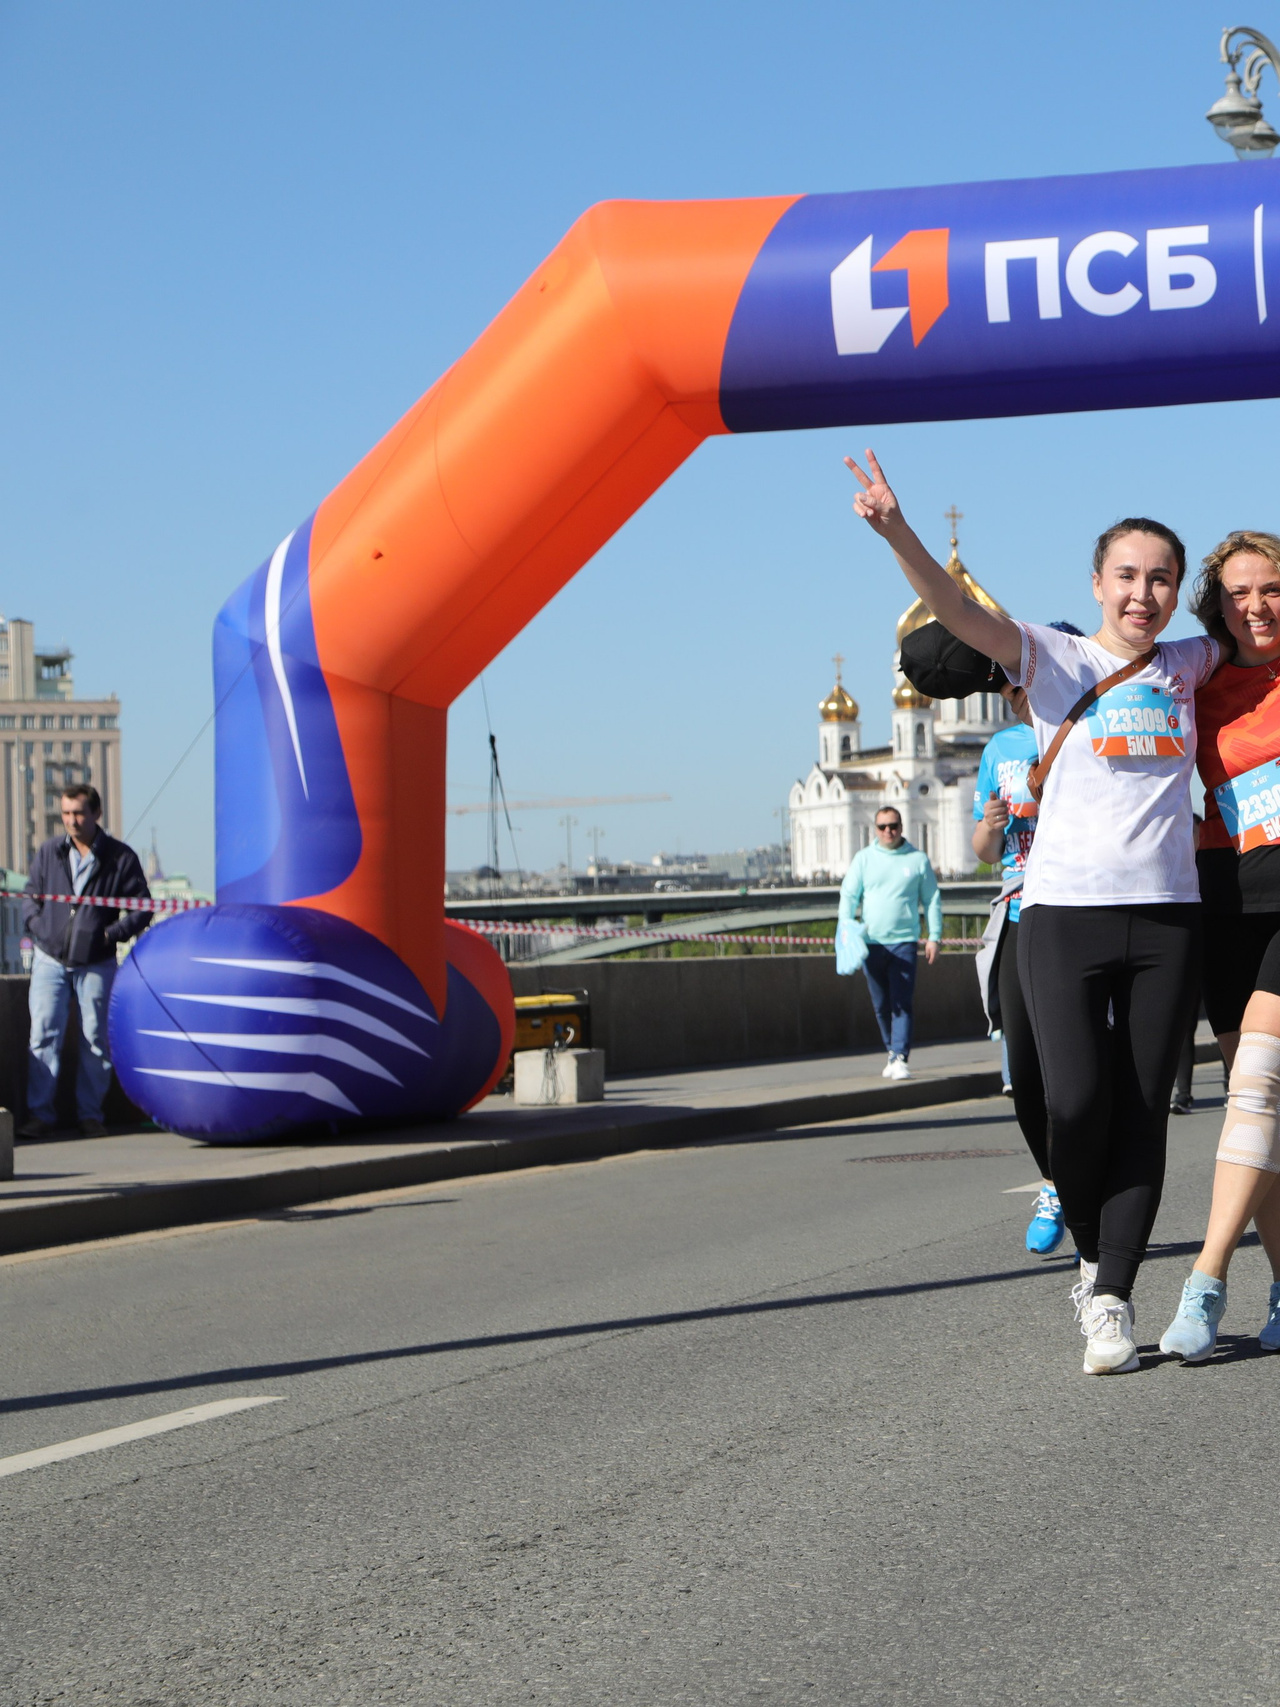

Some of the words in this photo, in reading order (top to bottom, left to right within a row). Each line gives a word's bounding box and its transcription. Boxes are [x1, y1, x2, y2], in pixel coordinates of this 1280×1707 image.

[984, 224, 1218, 323] ПСБ
[1105, 707, 1167, 733] 23309
[1169, 717, 1176, 727] F
